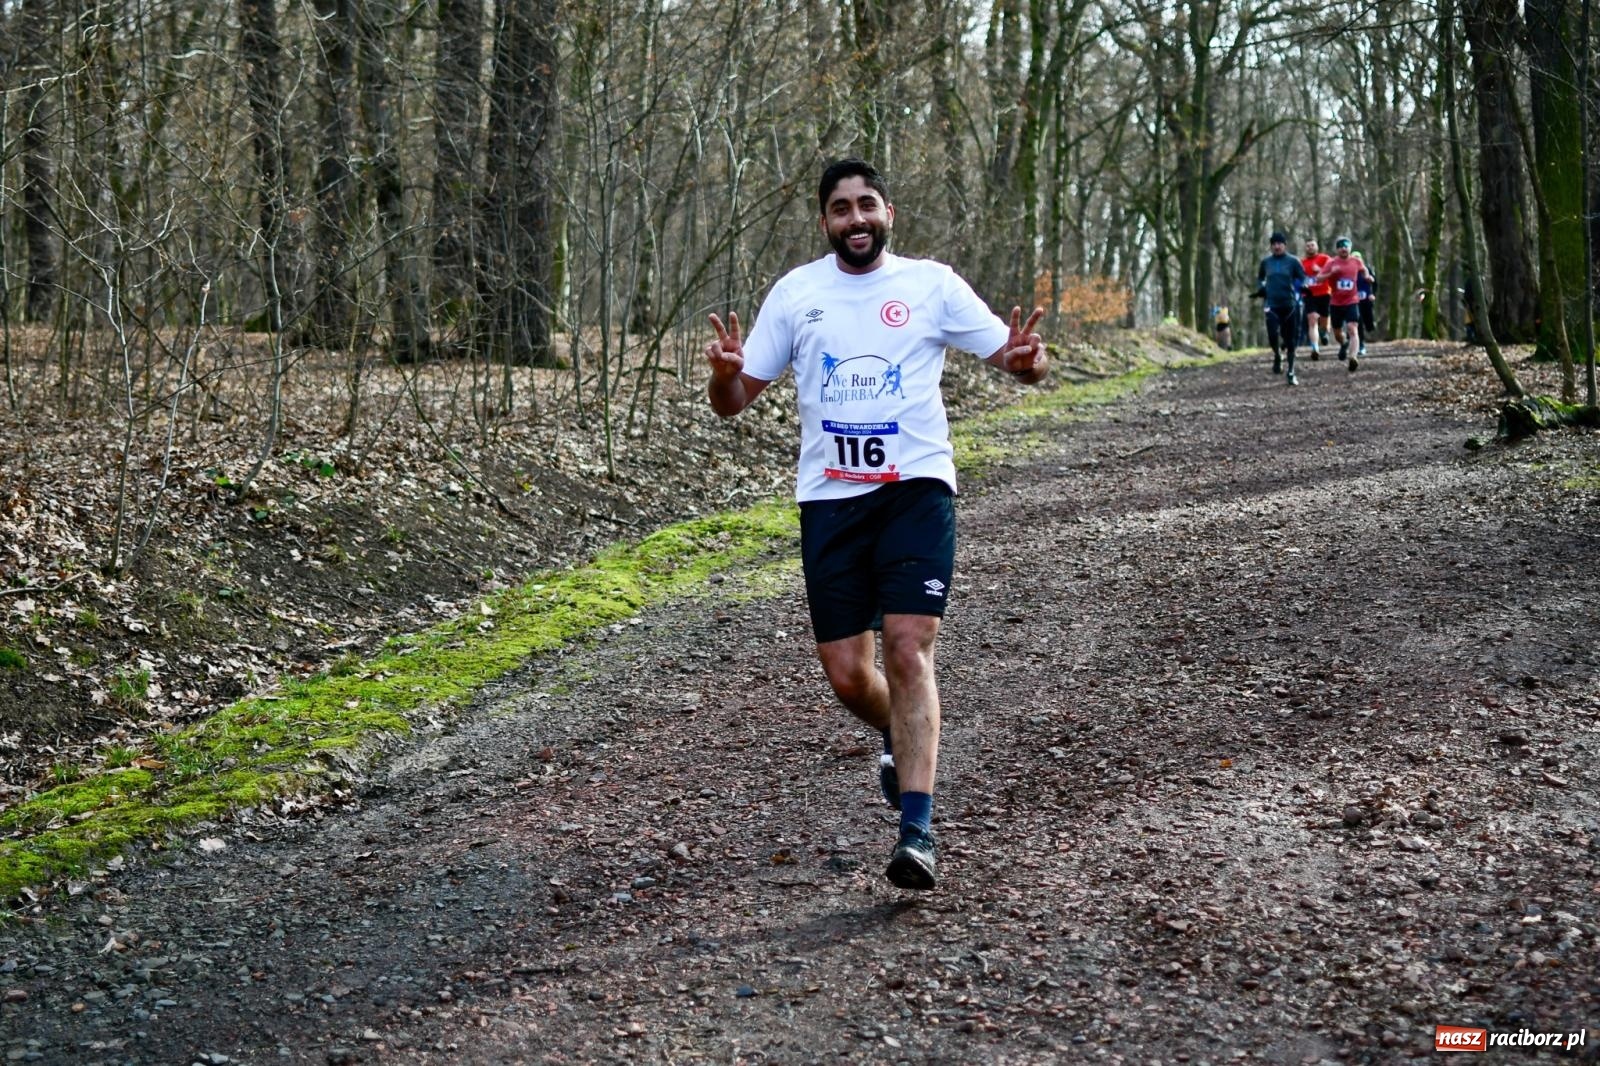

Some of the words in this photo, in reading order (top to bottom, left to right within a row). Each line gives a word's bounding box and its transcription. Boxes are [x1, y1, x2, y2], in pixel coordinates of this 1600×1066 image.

[832, 374, 847, 388] We
[851, 374, 876, 387] Run
[834, 436, 885, 467] 116
